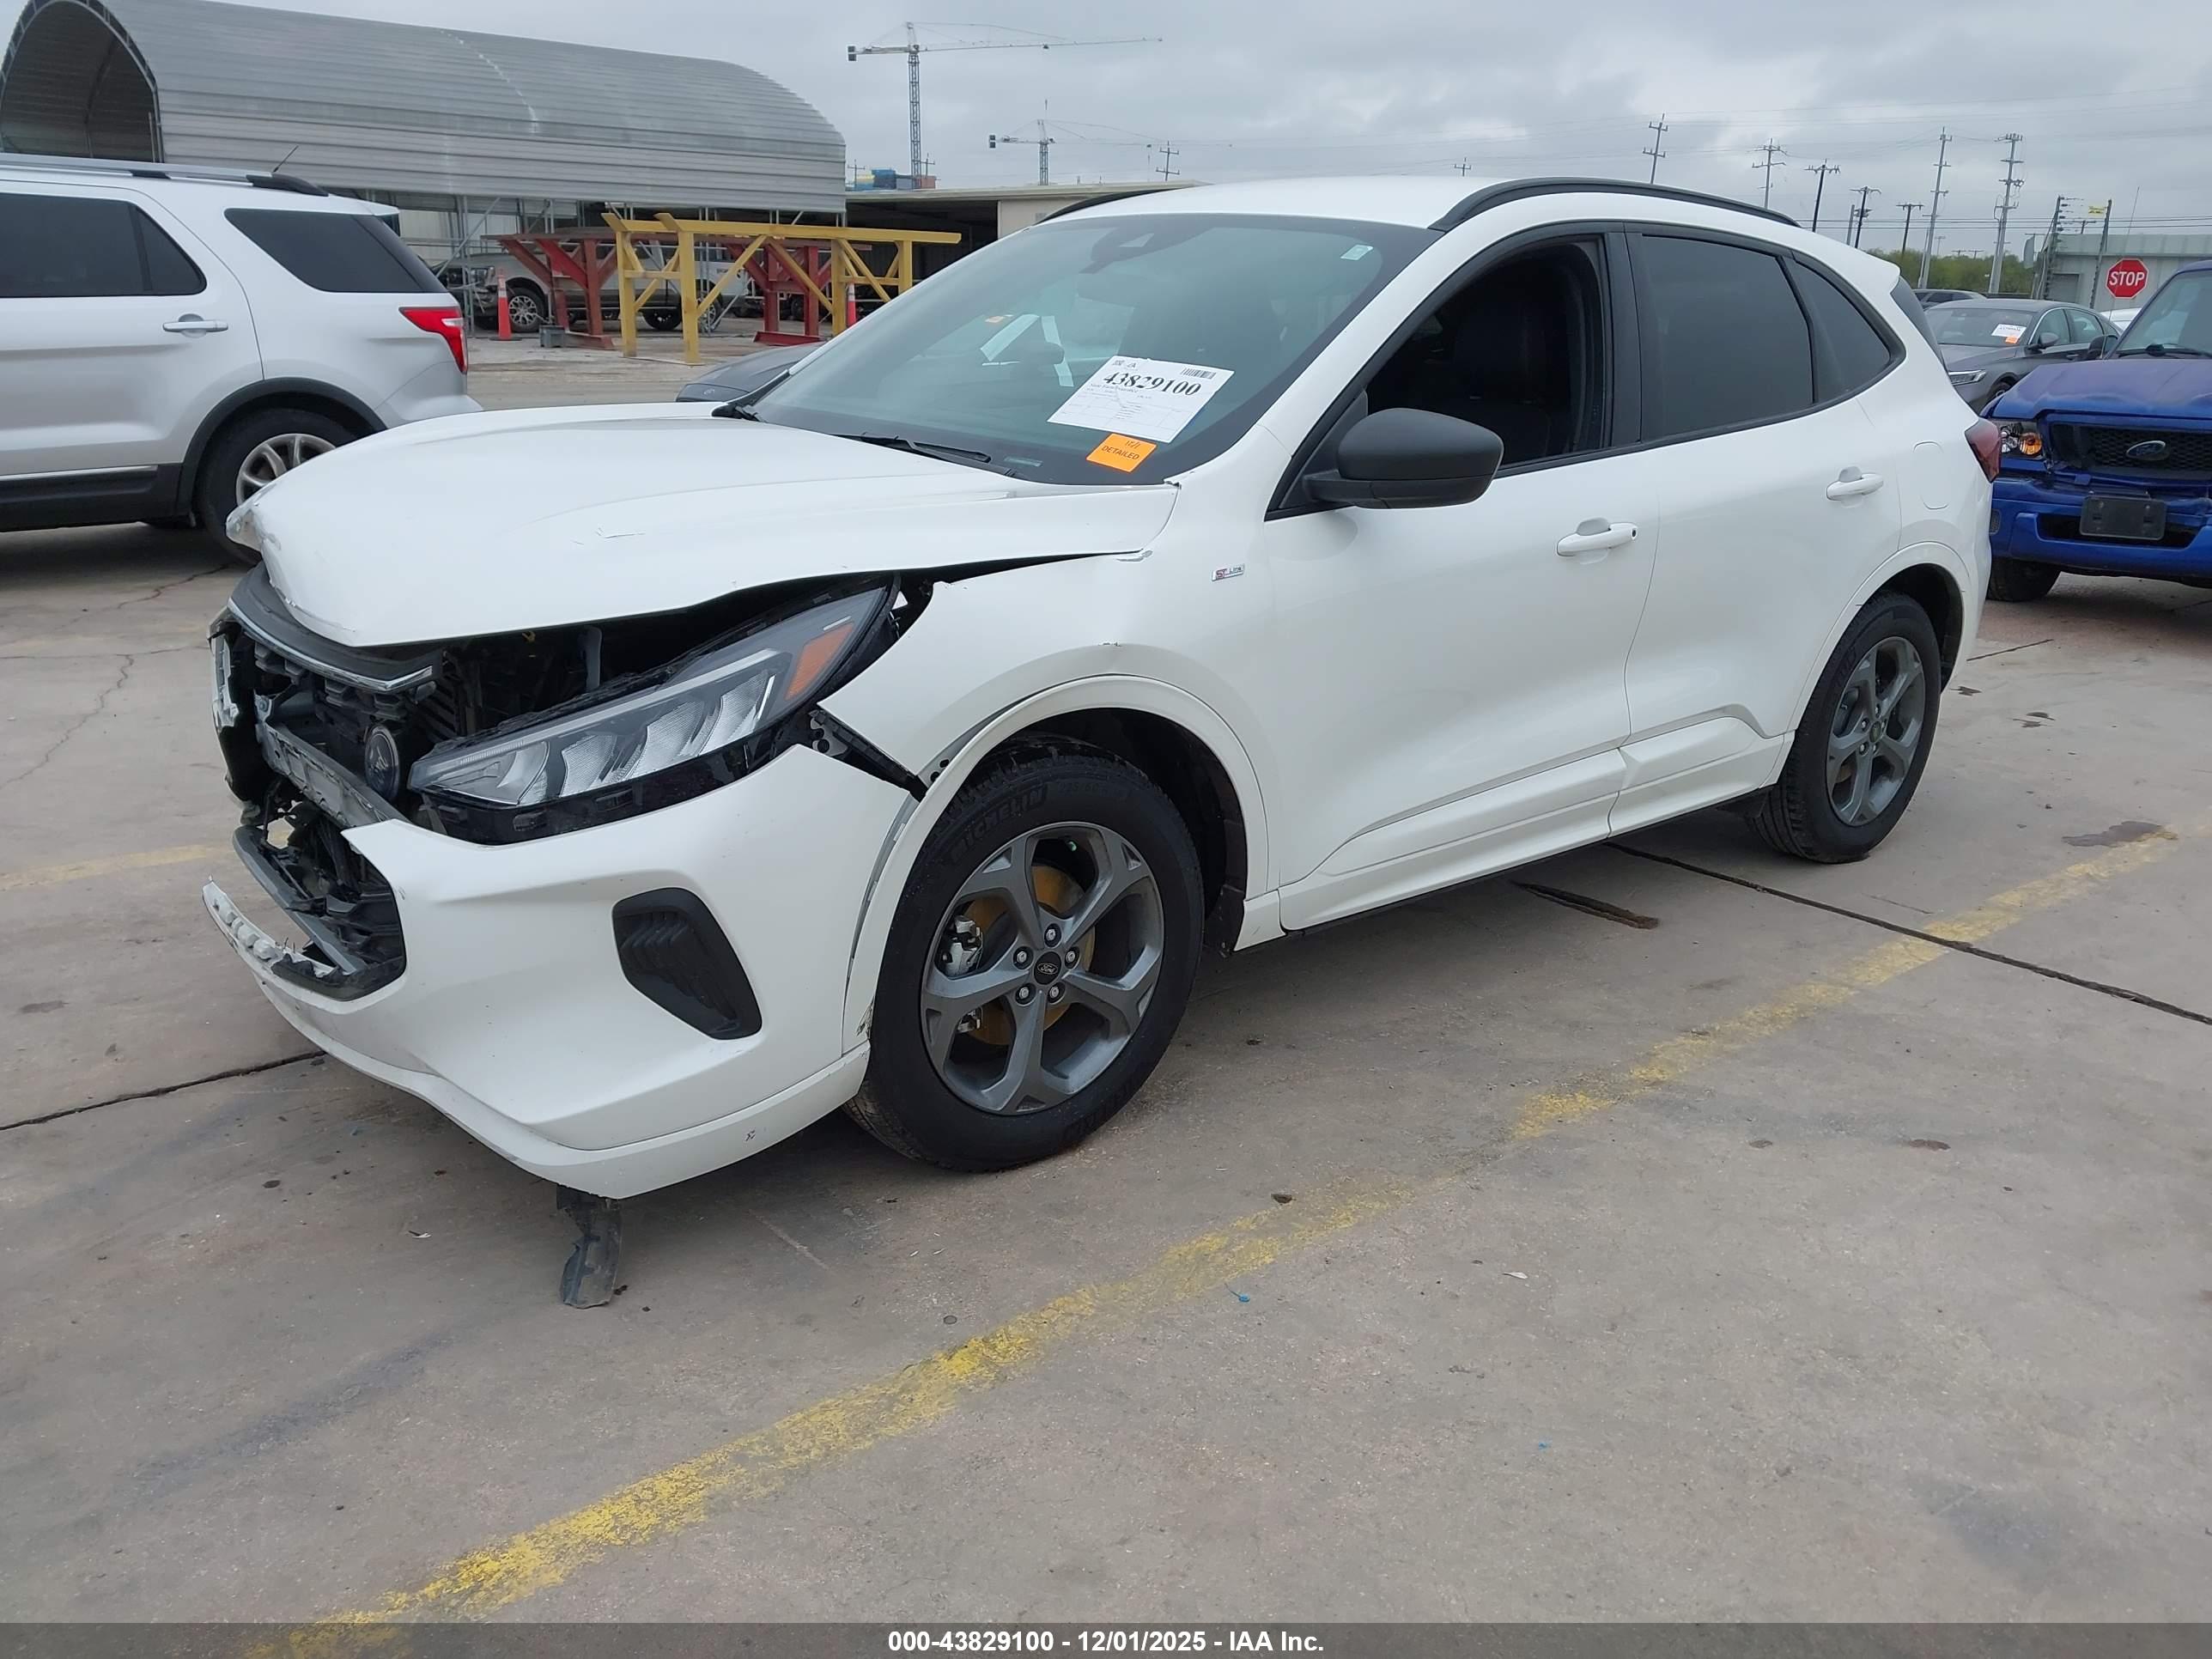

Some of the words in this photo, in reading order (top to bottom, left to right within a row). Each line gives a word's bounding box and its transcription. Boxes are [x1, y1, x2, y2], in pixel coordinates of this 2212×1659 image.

[2109, 270, 2145, 287] STOP
[1103, 372, 1201, 395] 43829100
[1102, 445, 1140, 460] DETAILED
